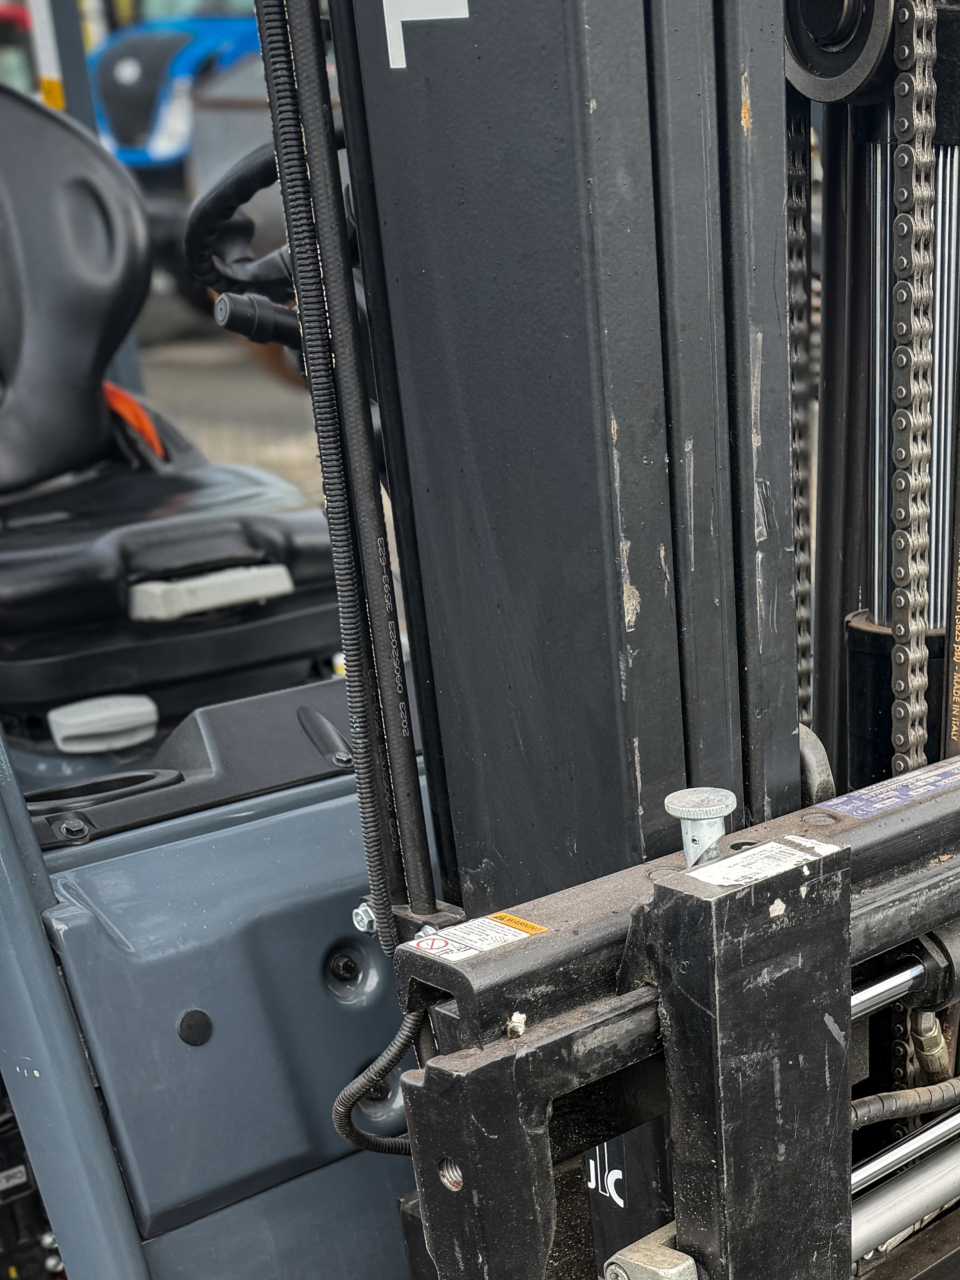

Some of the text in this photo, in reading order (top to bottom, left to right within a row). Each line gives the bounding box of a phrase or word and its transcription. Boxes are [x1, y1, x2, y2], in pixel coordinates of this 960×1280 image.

[952, 673, 960, 702] MADE
[399, 701, 410, 737] 2023
[951, 705, 959, 715] IN
[951, 718, 959, 741] ITALY
